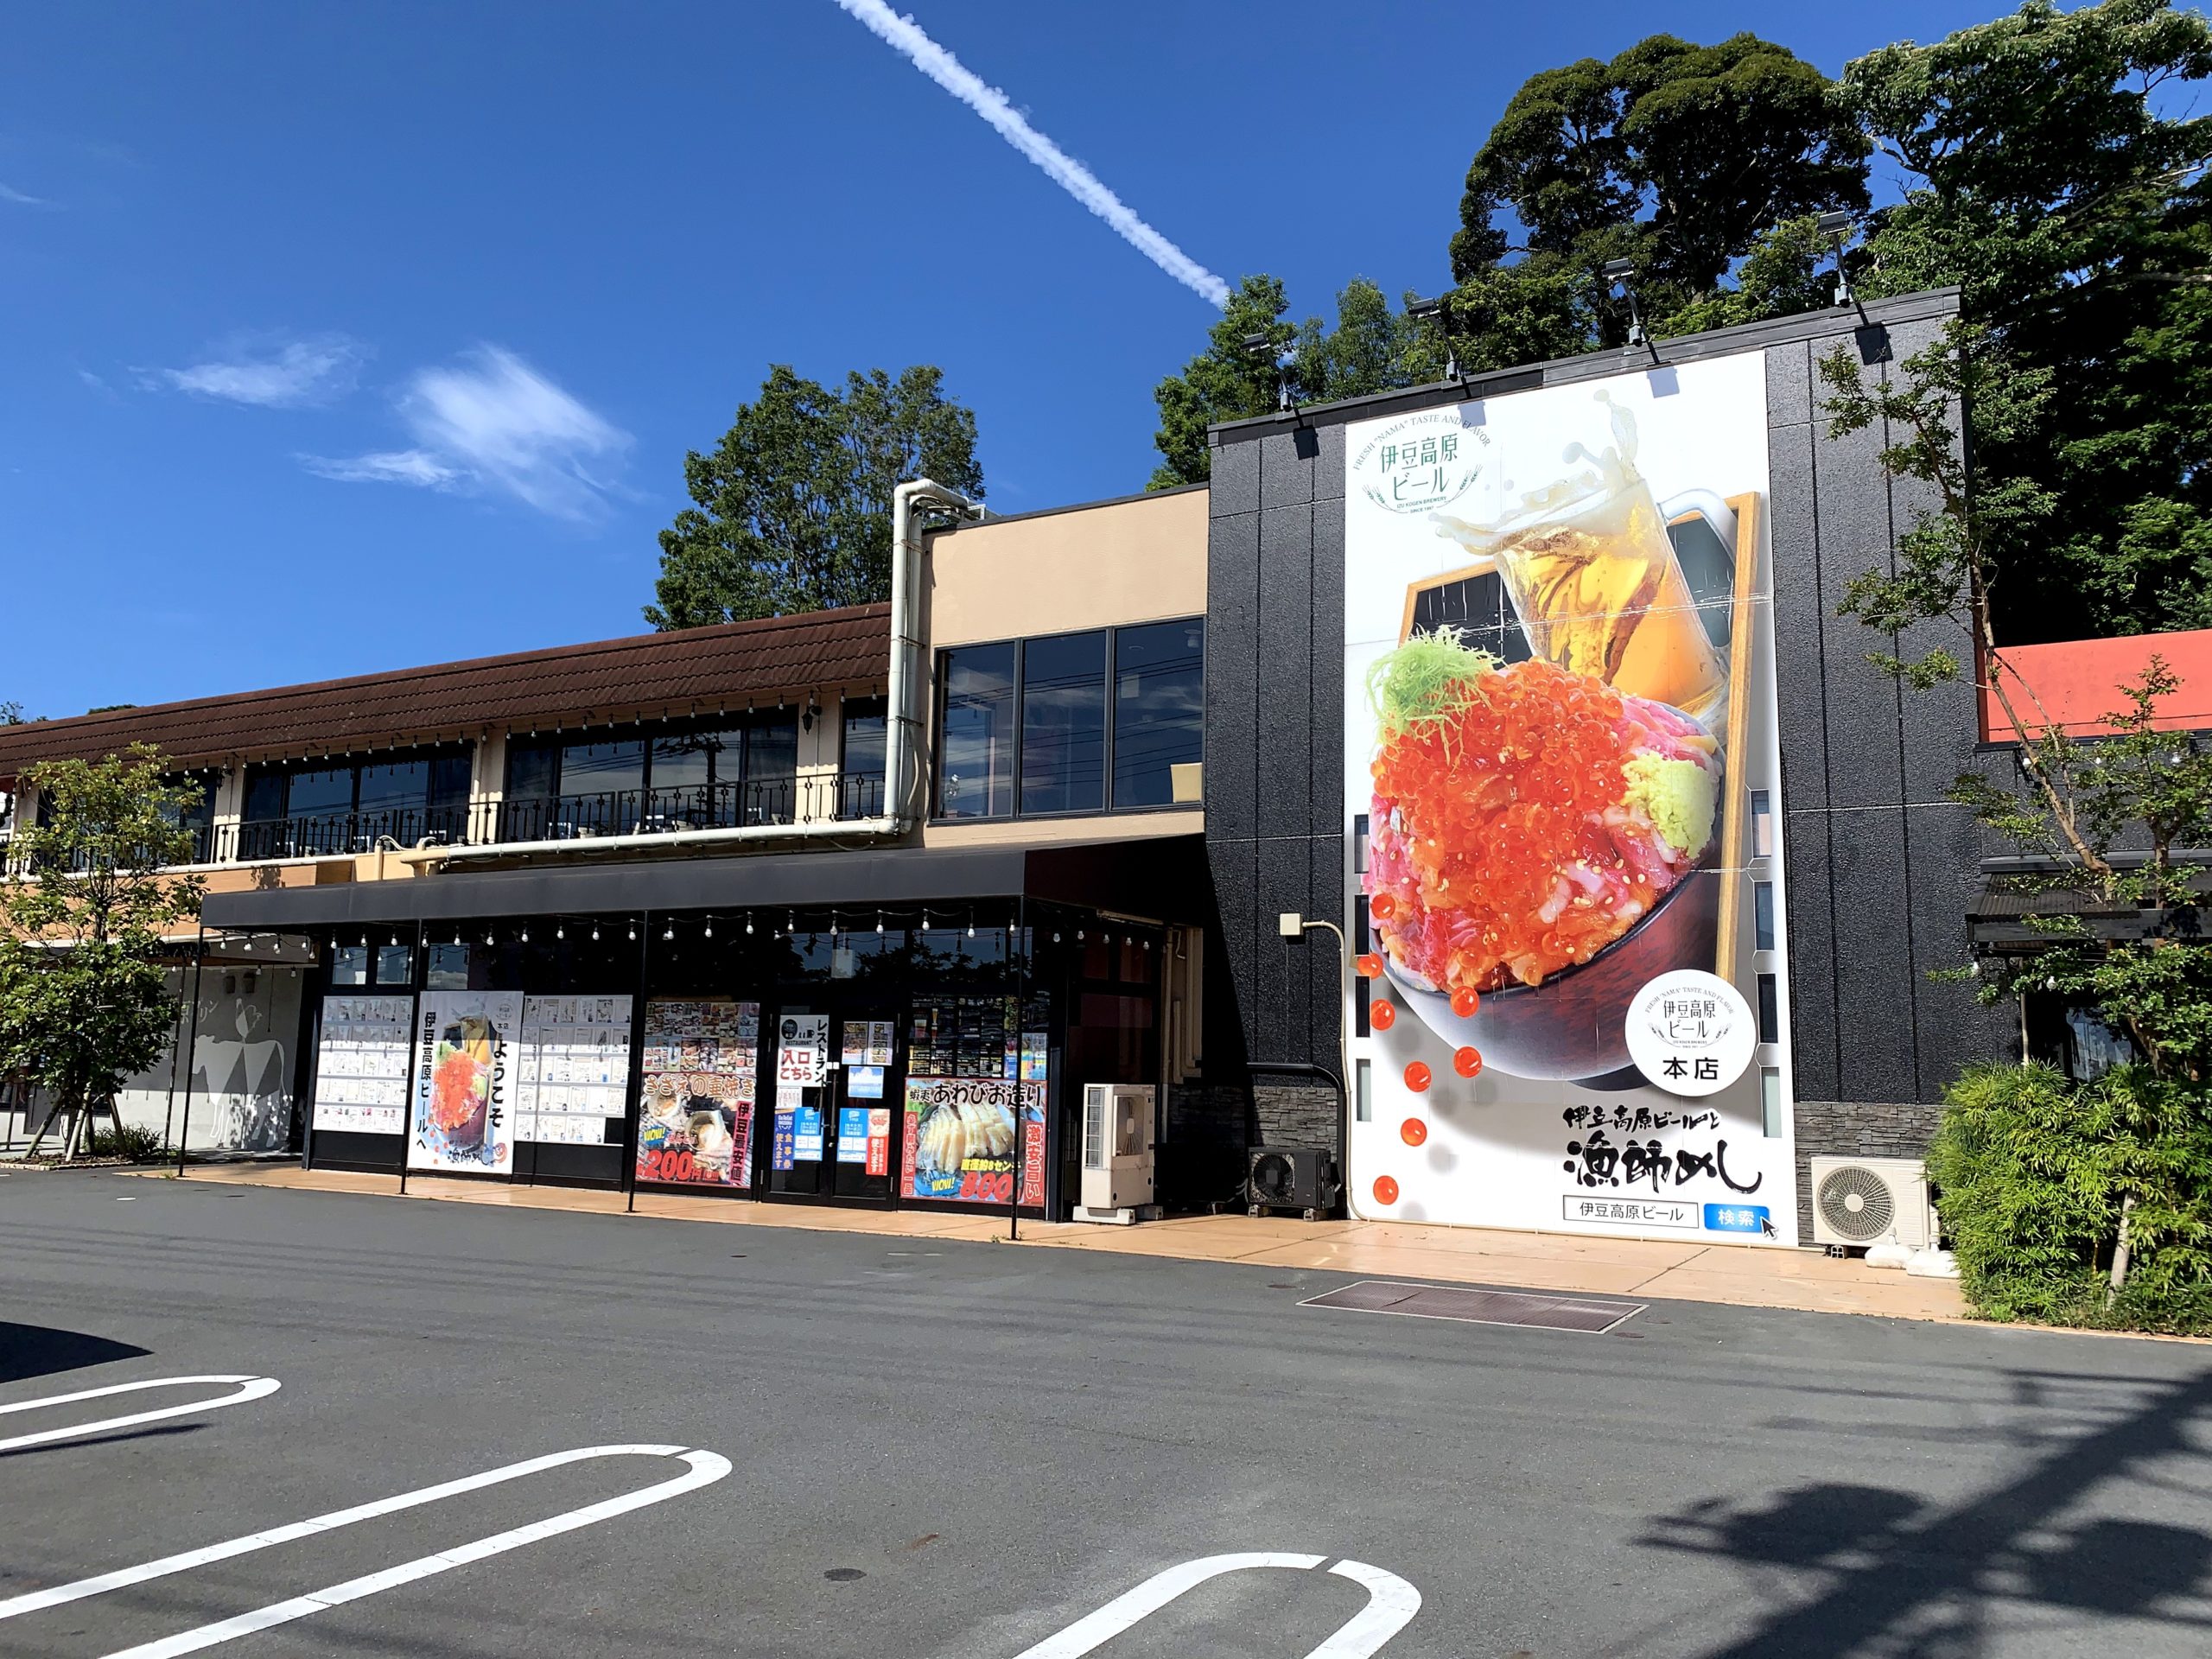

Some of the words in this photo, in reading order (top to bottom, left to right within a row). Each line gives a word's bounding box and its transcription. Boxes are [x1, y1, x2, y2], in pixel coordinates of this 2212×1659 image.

[1409, 414, 1440, 427] TASTE
[1441, 416, 1462, 425] AND
[1380, 433, 1459, 474] 伊豆高原
[1394, 467, 1450, 501] ビール
[1663, 1000, 1716, 1019] 伊豆高原
[1669, 1020, 1710, 1039] ビール
[781, 1050, 810, 1065] 入口
[1662, 1057, 1719, 1080] 本店
[416, 1011, 436, 1150] 伊豆高原ビールへ
[489, 1033, 508, 1128] ようこそ
[780, 1066, 812, 1080] こちら
[645, 1149, 693, 1180] 200
[1563, 1130, 1762, 1194] 漁師めし
[960, 1172, 1013, 1199] 800
[1580, 1201, 1684, 1221] 伊豆高原ビール
[1718, 1209, 1755, 1226] 検索
